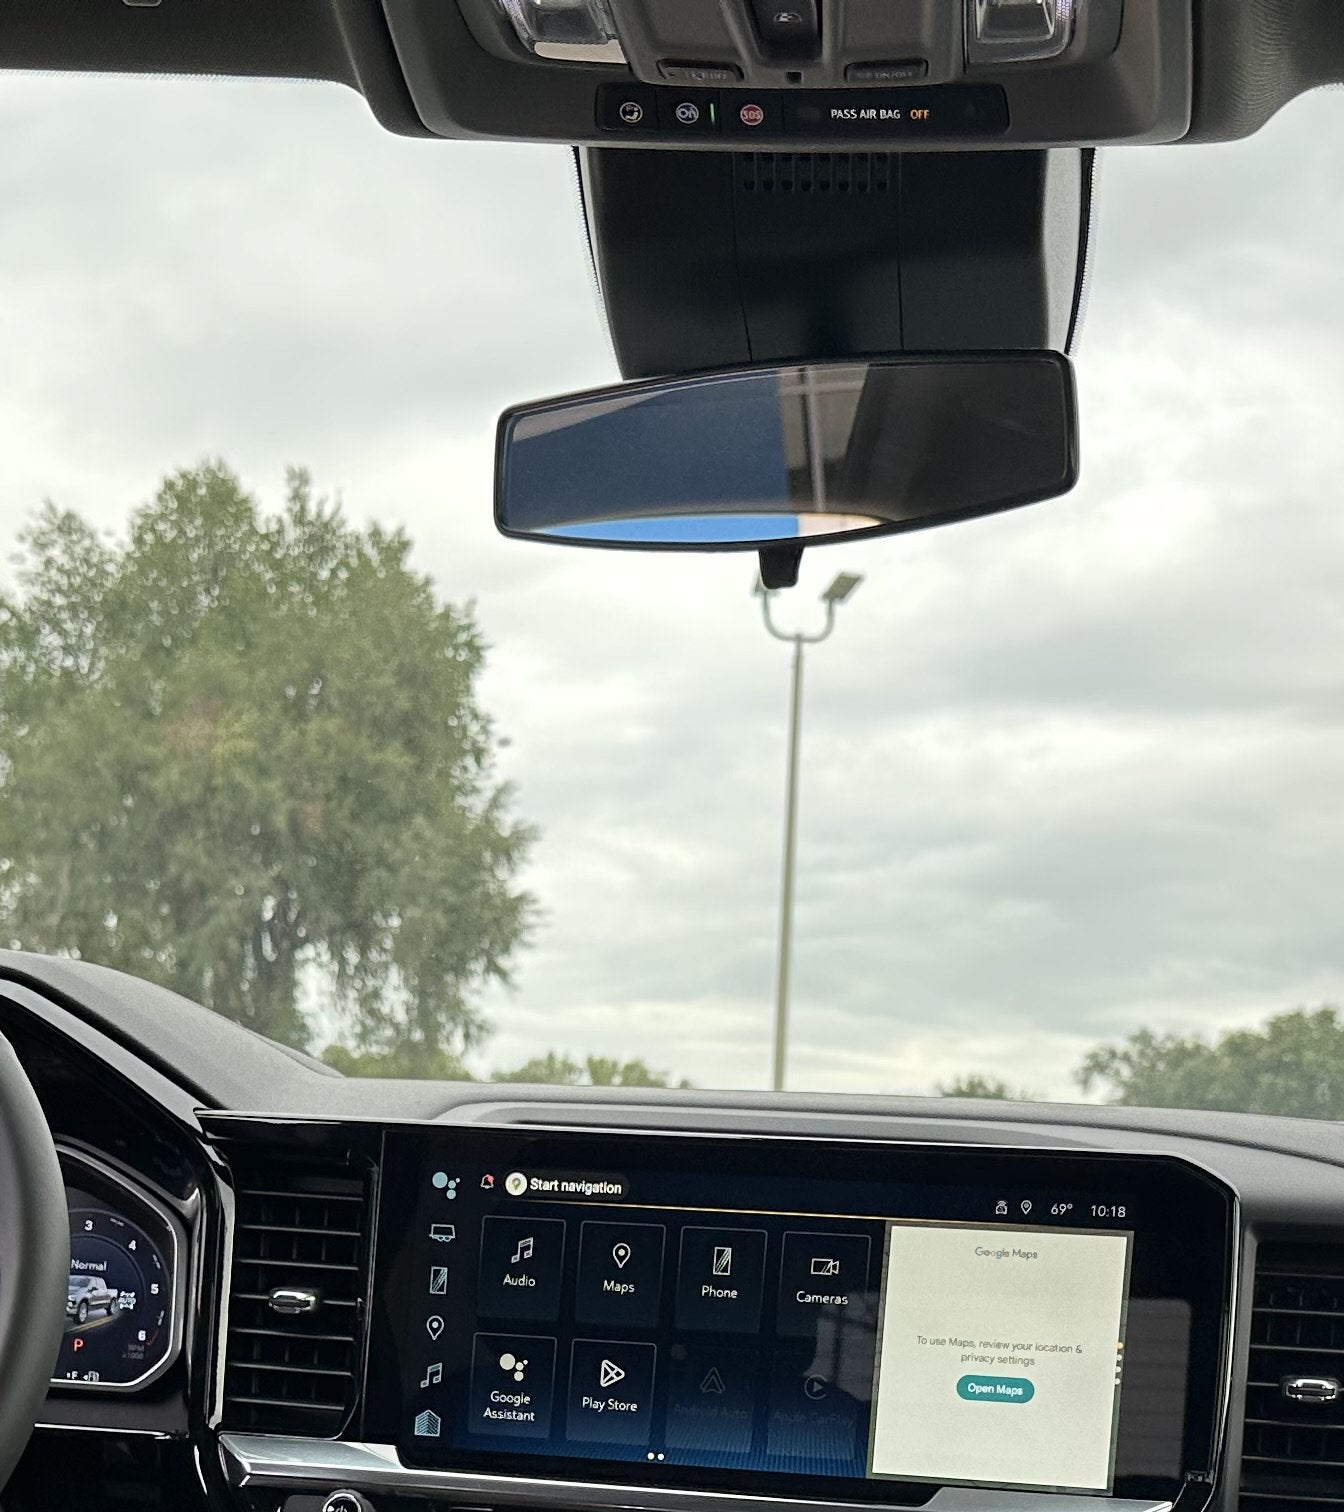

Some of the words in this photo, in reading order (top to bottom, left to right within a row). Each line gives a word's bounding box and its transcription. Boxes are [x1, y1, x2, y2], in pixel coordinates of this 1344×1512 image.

[742, 109, 763, 120] SOS
[830, 109, 857, 120] PASS
[859, 109, 877, 120] AIR
[879, 109, 901, 120] BAG
[910, 109, 930, 120] OFF
[530, 1178, 558, 1192] Start
[561, 1180, 622, 1195] navigation
[1090, 1204, 1126, 1218] 10:18
[84, 1219, 93, 1231] 3
[128, 1240, 137, 1251] 4
[975, 1246, 1010, 1260] Google
[1012, 1248, 1038, 1261] Maps
[71, 1258, 107, 1271] Normal
[503, 1273, 536, 1287] Audio
[150, 1283, 159, 1295] 5
[602, 1280, 635, 1295] Maps
[701, 1285, 738, 1299] Phone
[796, 1290, 849, 1305] Cameras
[73, 1338, 84, 1352] P
[916, 1335, 927, 1345] To
[929, 1337, 947, 1346] use
[948, 1337, 976, 1349] Maps,
[978, 1340, 1010, 1350] review
[1012, 1342, 1033, 1352] your
[1035, 1342, 1073, 1354] location
[1075, 1344, 1083, 1354] &
[960, 1353, 995, 1365] privacy
[997, 1355, 1035, 1367] settings
[967, 1382, 994, 1395] Open
[996, 1383, 1023, 1397] Maps
[490, 1390, 531, 1407] Google
[582, 1396, 605, 1413] Play
[607, 1398, 638, 1412] Store
[483, 1407, 535, 1422] Assistant
